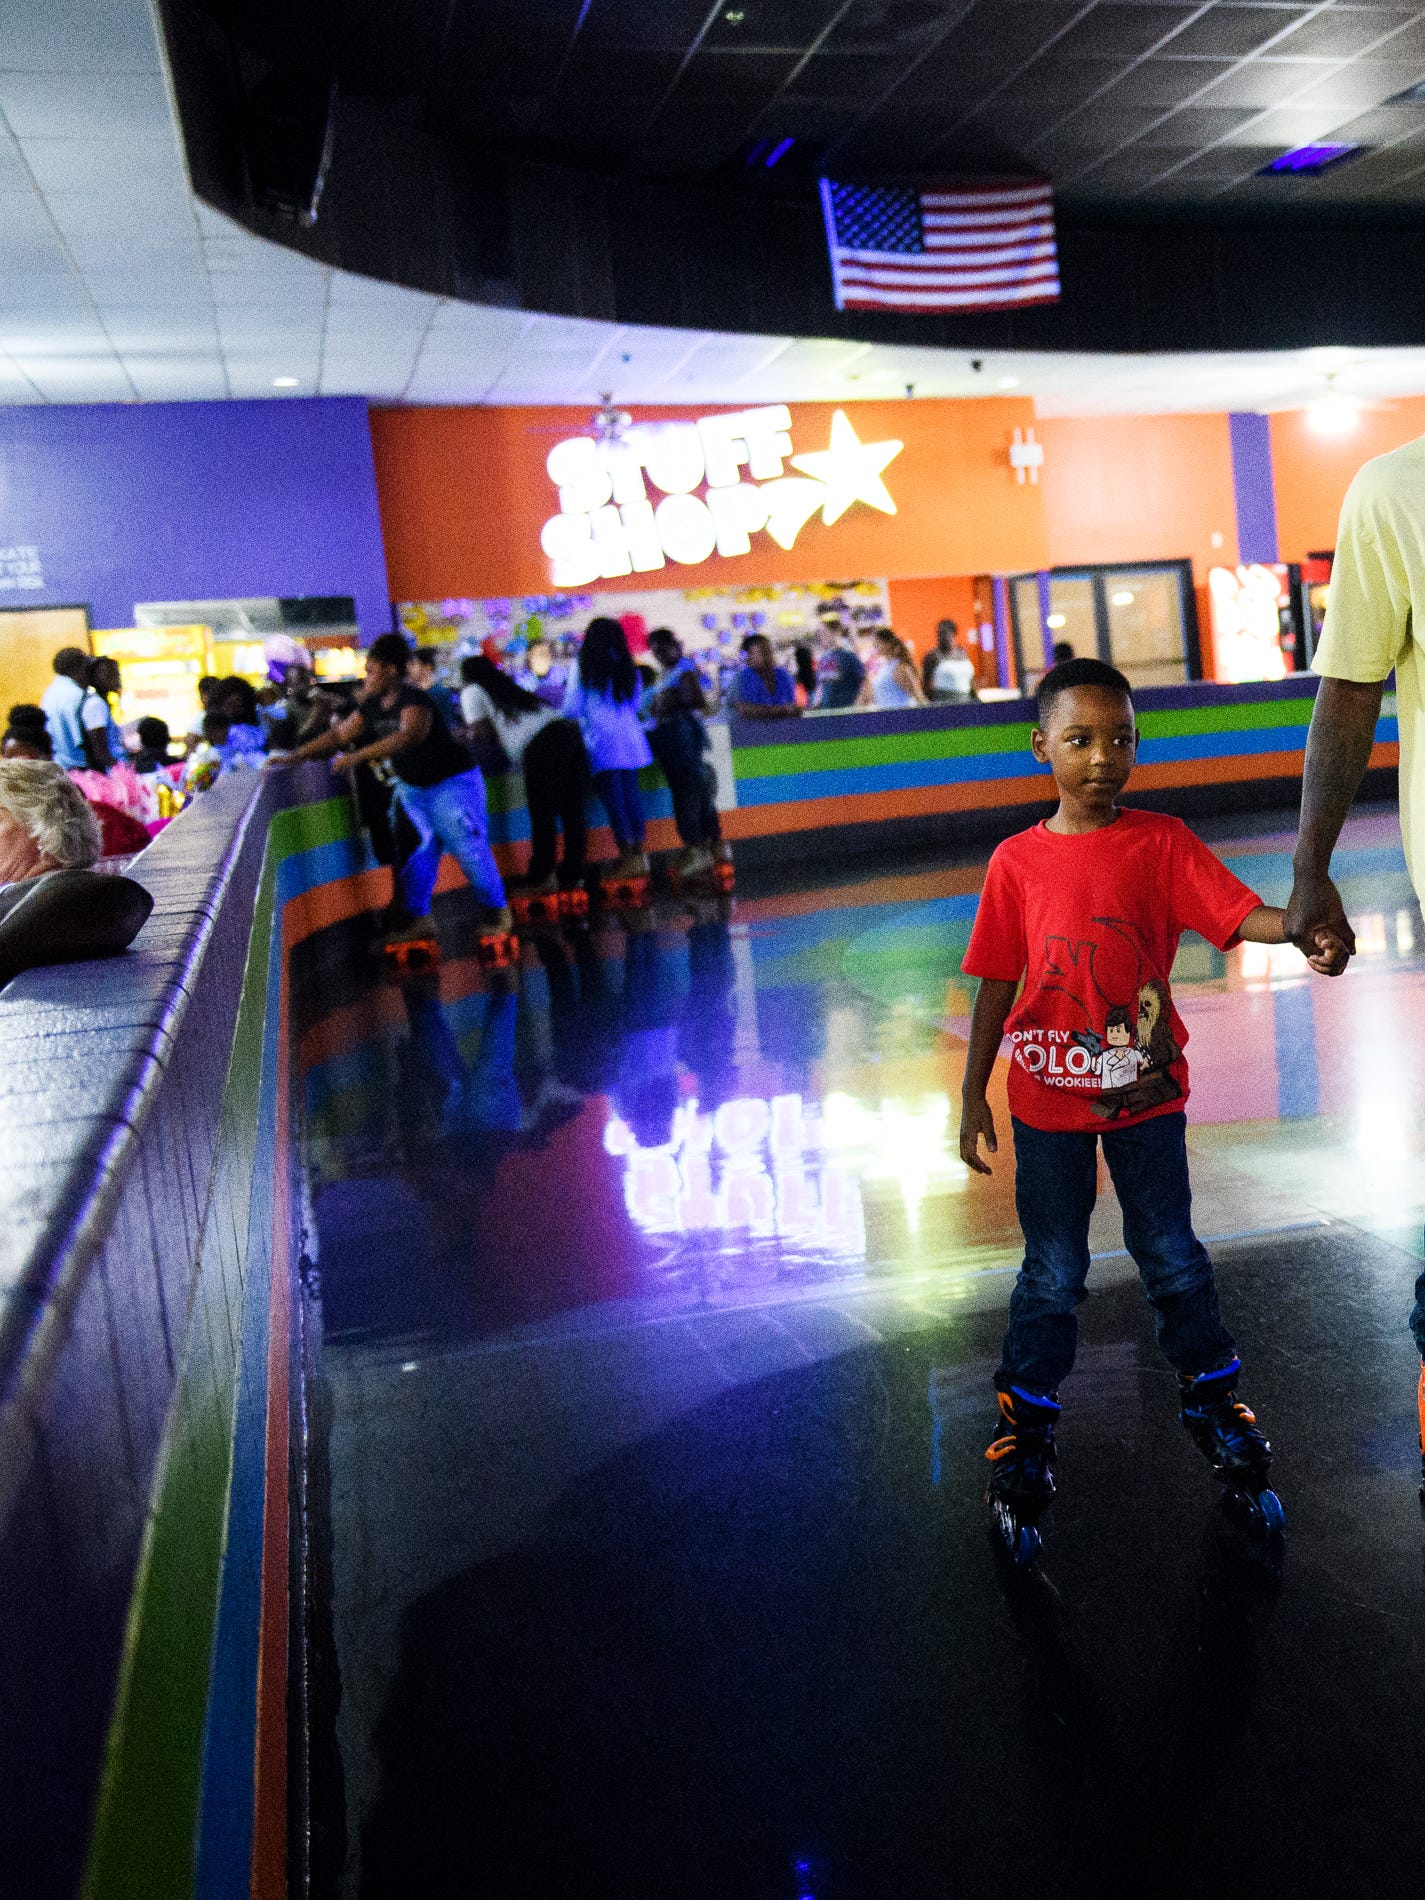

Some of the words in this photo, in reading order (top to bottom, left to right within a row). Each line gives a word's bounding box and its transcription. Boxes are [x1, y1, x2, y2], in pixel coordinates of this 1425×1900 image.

[547, 403, 794, 514] STUFF
[541, 482, 771, 588] SHOP
[1048, 1030, 1069, 1042] FLY
[1023, 1043, 1091, 1075] OLO
[1044, 1077, 1101, 1087] WOOKIEE!
